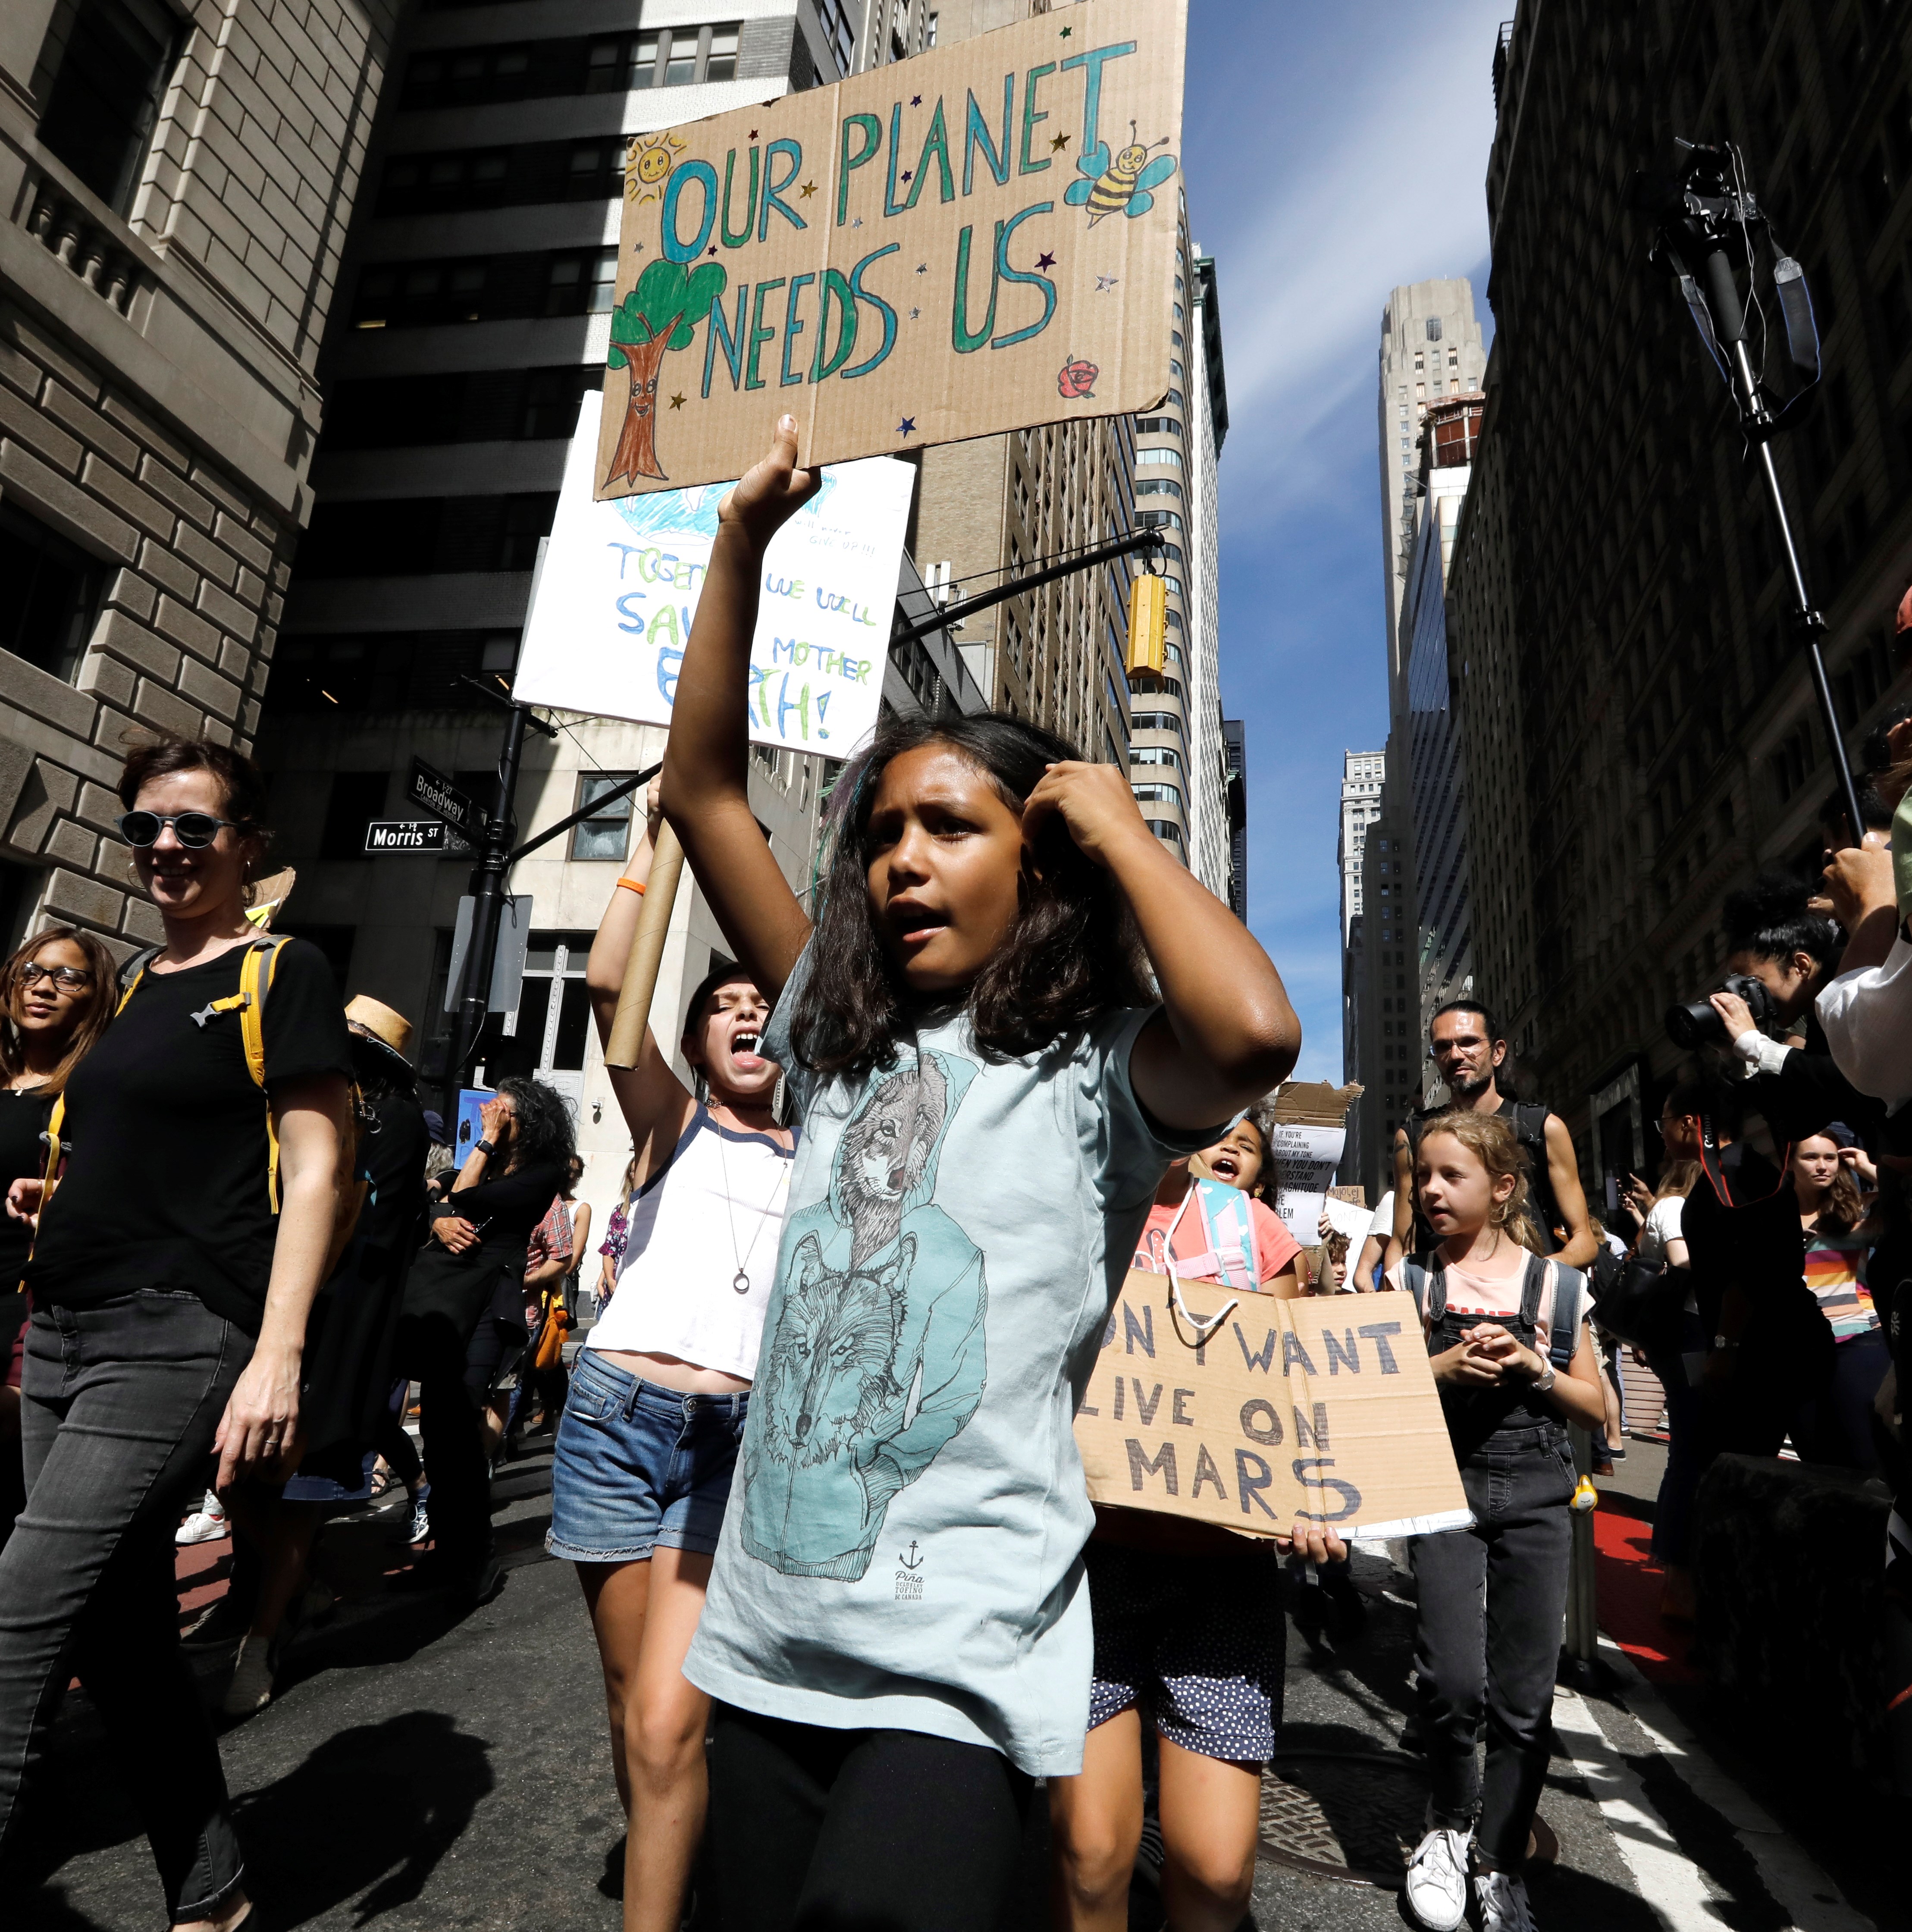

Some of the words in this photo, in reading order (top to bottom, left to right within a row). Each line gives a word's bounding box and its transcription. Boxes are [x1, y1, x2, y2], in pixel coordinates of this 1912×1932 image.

[661, 138, 807, 263] OUR
[837, 41, 1137, 226] PLANET
[702, 243, 900, 398] NEEDS
[952, 201, 1056, 353] US
[809, 536, 837, 547] GIVE
[766, 573, 805, 599] WE
[816, 587, 877, 627] WILL
[773, 637, 872, 685] MOTHER
[416, 774, 464, 822] Broadway
[420, 794, 435, 807] CANYON
[442, 783, 452, 795] 1-27
[373, 828, 423, 846] Morris
[428, 828, 439, 837] ST
[1277, 1140, 1309, 1149] COMPLAINING
[1292, 1159, 1308, 1169] YOU
[1308, 1160, 1332, 1170] DON'T
[1232, 1321, 1401, 1376] WANT
[1240, 1399, 1330, 1451] ON
[1125, 1438, 1361, 1522] MARS
[895, 1571, 925, 1583] Piña
